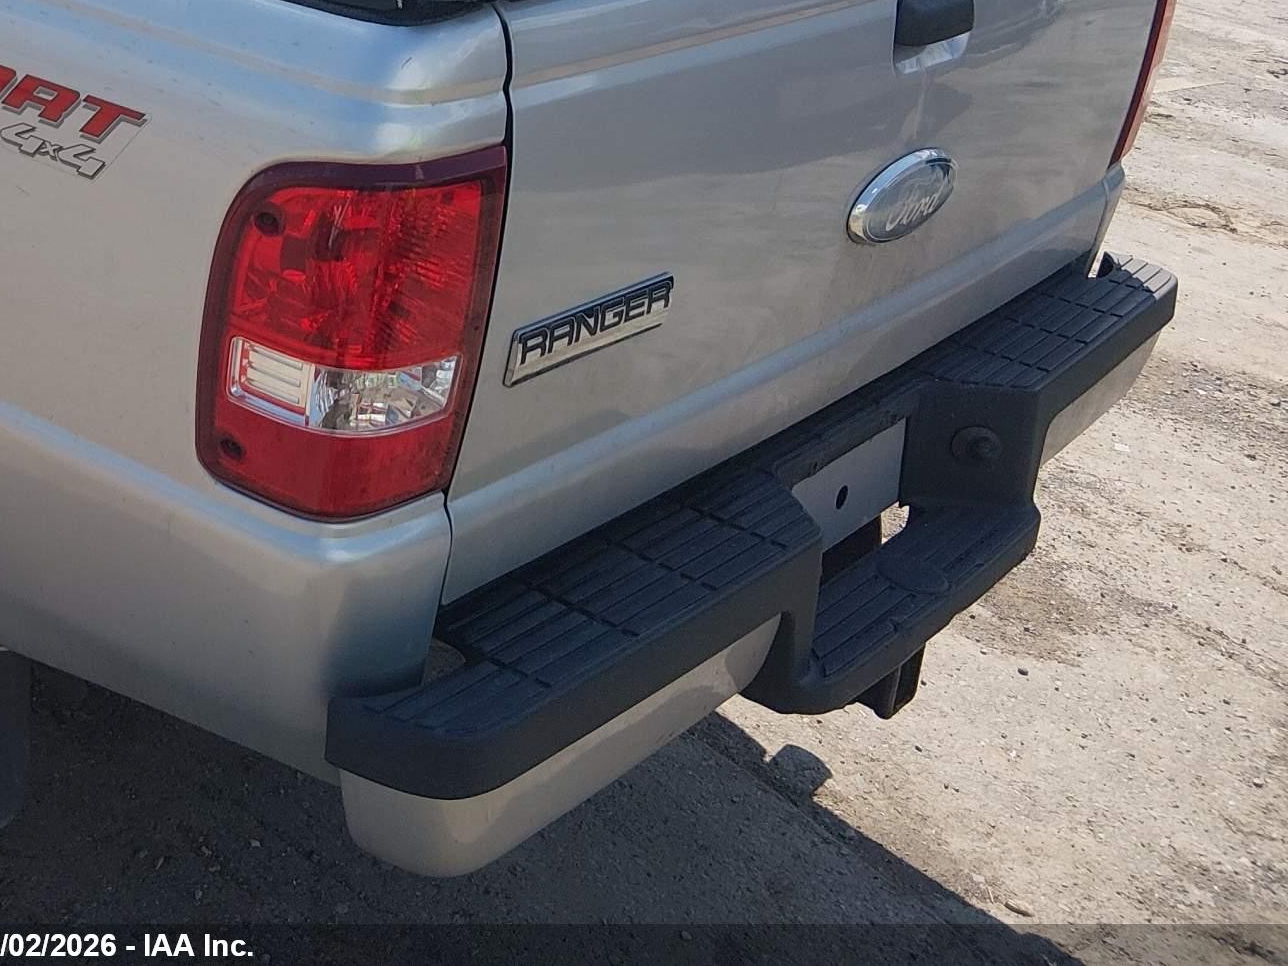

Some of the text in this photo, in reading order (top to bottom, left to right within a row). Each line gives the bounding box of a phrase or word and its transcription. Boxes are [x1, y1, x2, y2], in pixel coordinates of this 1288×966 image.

[0, 122, 105, 180] 4x4
[885, 178, 950, 231] Ford
[518, 280, 673, 366] RANGER
